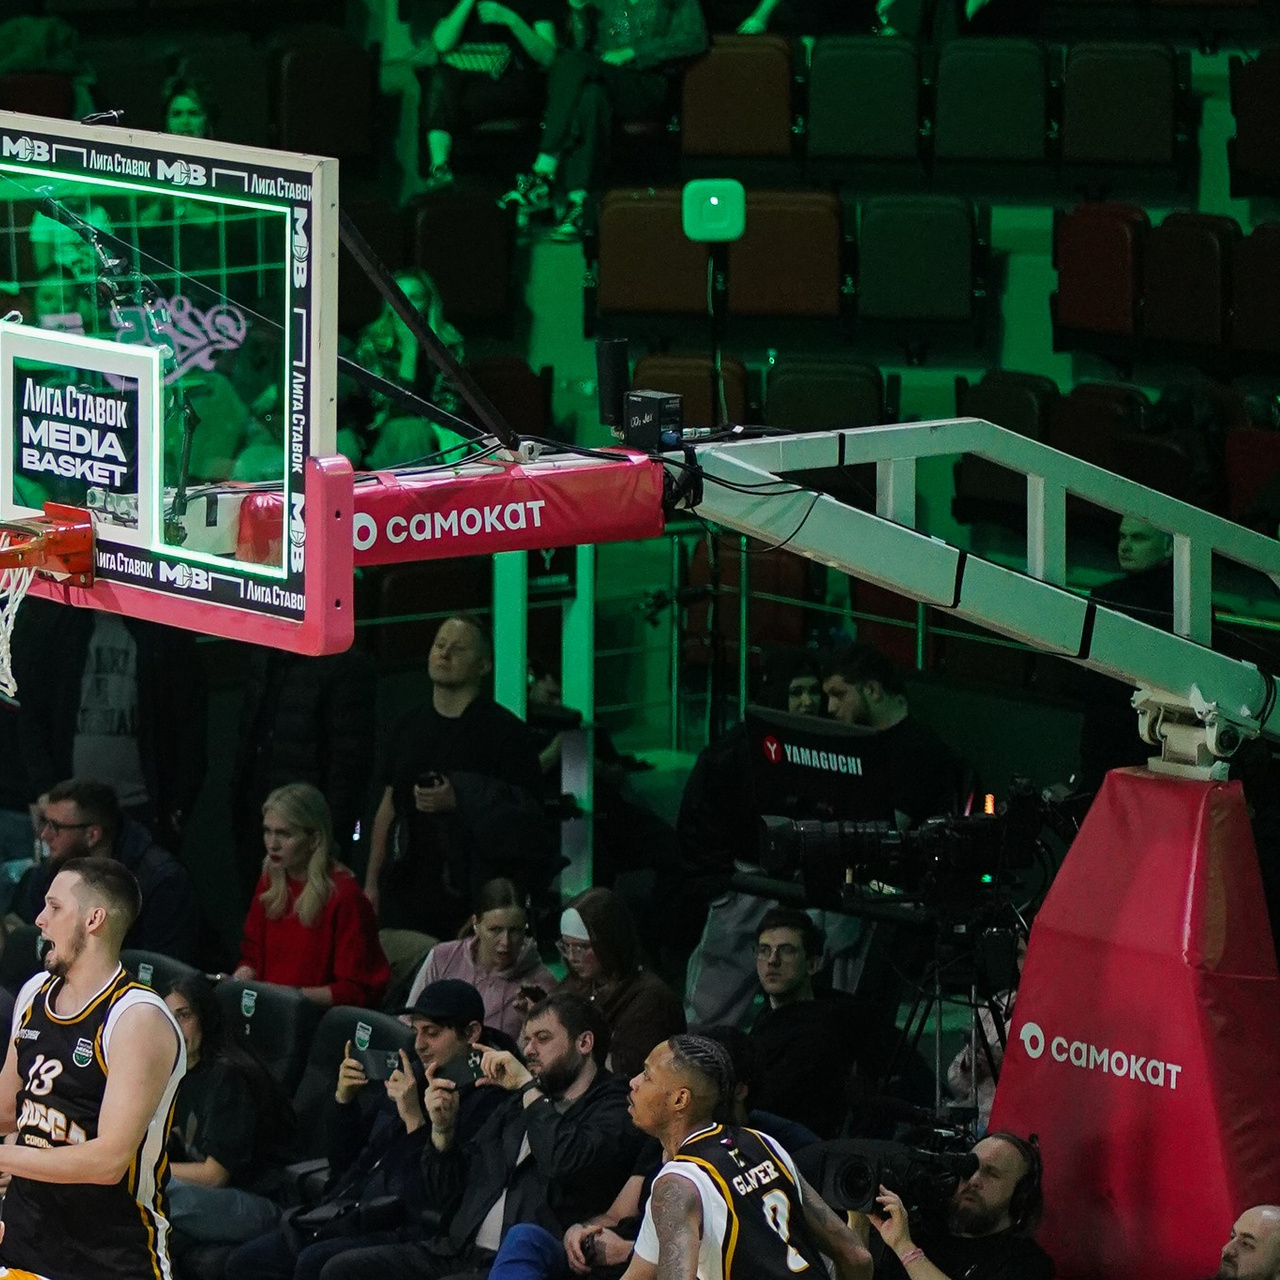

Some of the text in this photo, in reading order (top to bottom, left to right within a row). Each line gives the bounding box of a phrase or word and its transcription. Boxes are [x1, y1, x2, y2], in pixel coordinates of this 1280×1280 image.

[22, 416, 128, 463] MEDIA
[22, 447, 128, 487] BASKET
[386, 500, 546, 543] самокат
[784, 743, 863, 776] YAMAGUCHI
[24, 1054, 63, 1096] 13
[1050, 1036, 1182, 1090] самокат
